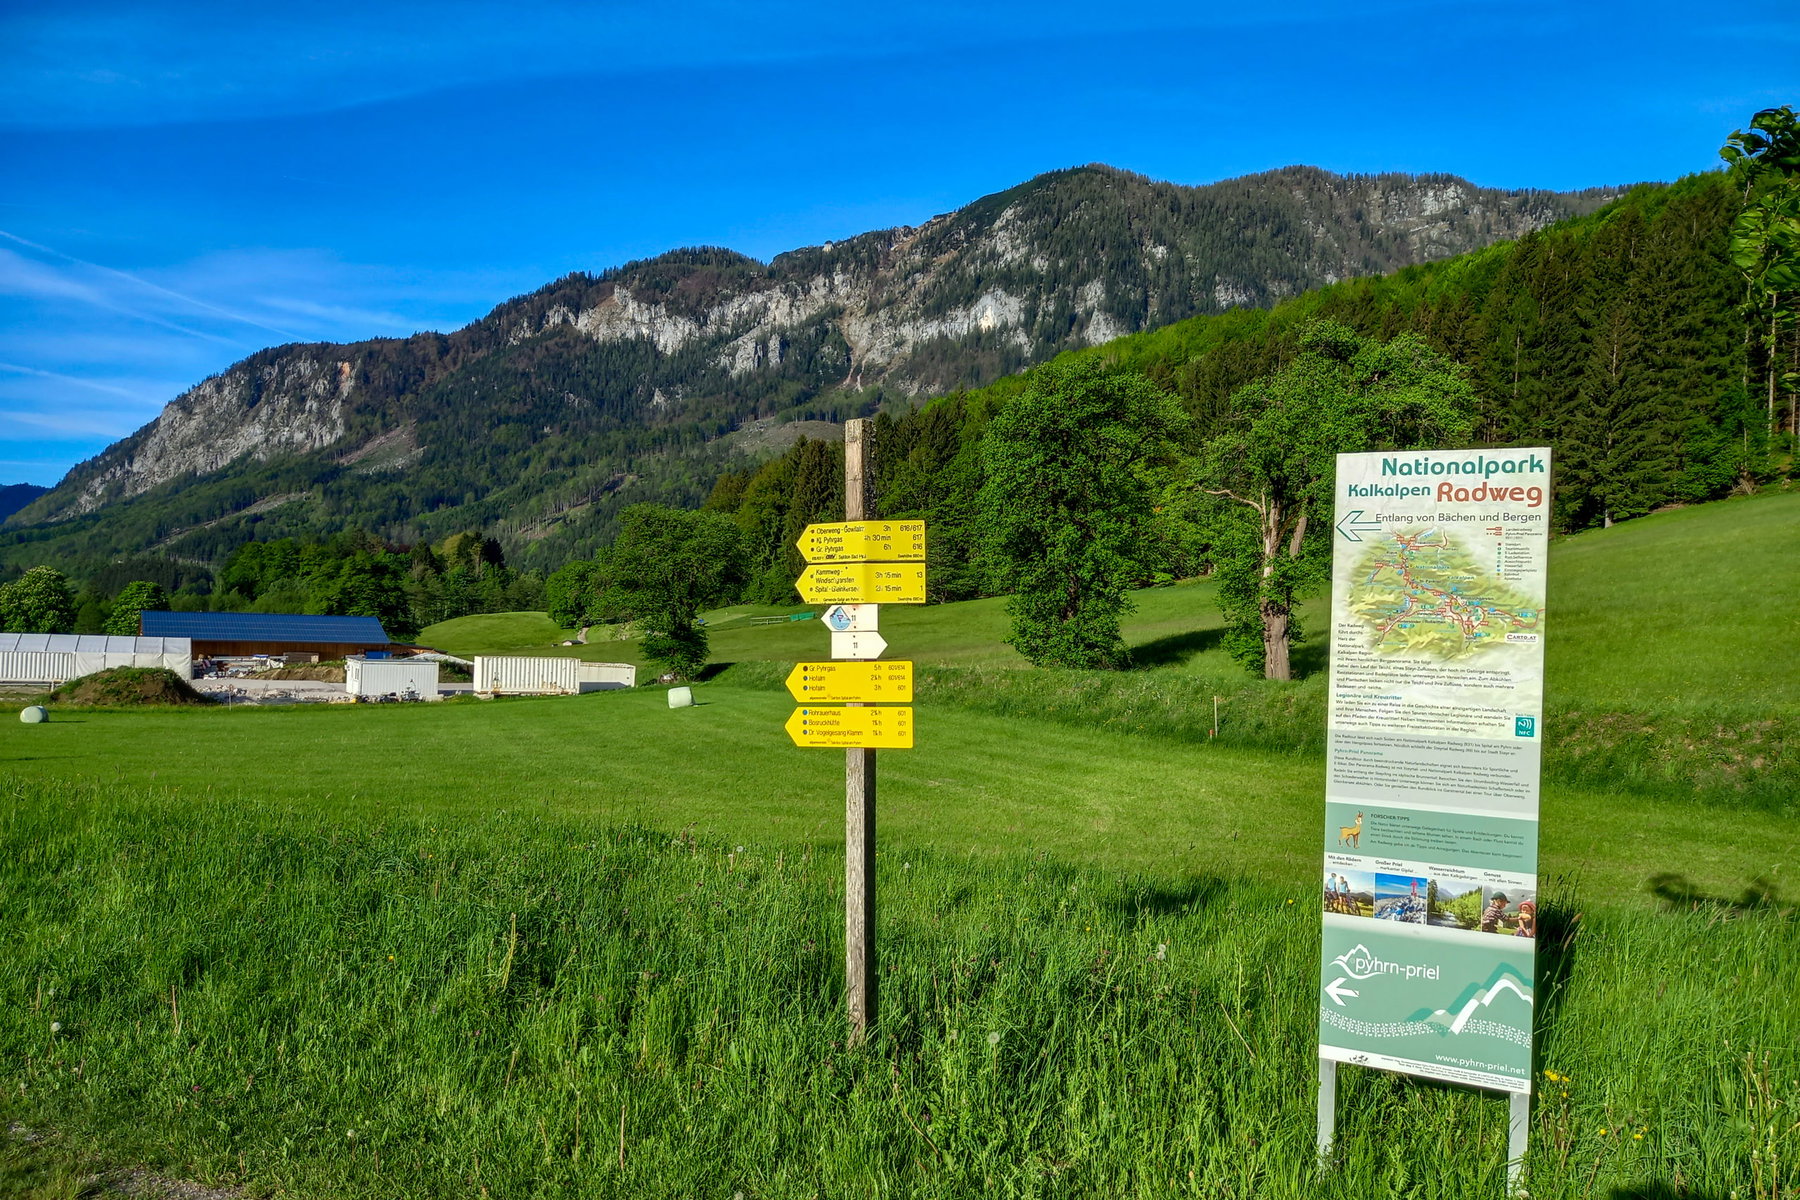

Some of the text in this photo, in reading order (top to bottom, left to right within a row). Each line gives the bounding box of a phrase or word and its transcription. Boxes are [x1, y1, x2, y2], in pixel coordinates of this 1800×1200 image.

[1382, 455, 1545, 479] Nationalpark
[1348, 482, 1543, 507] Kalkalpen Radweg
[1376, 513, 1413, 523] Entlang
[1438, 513, 1477, 521] Bächen
[1479, 513, 1499, 521] und
[1503, 513, 1541, 523] Bergen
[1355, 957, 1440, 980] pyhrn-priel
[1435, 1053, 1525, 1075] www.pyhrn-priel.net
